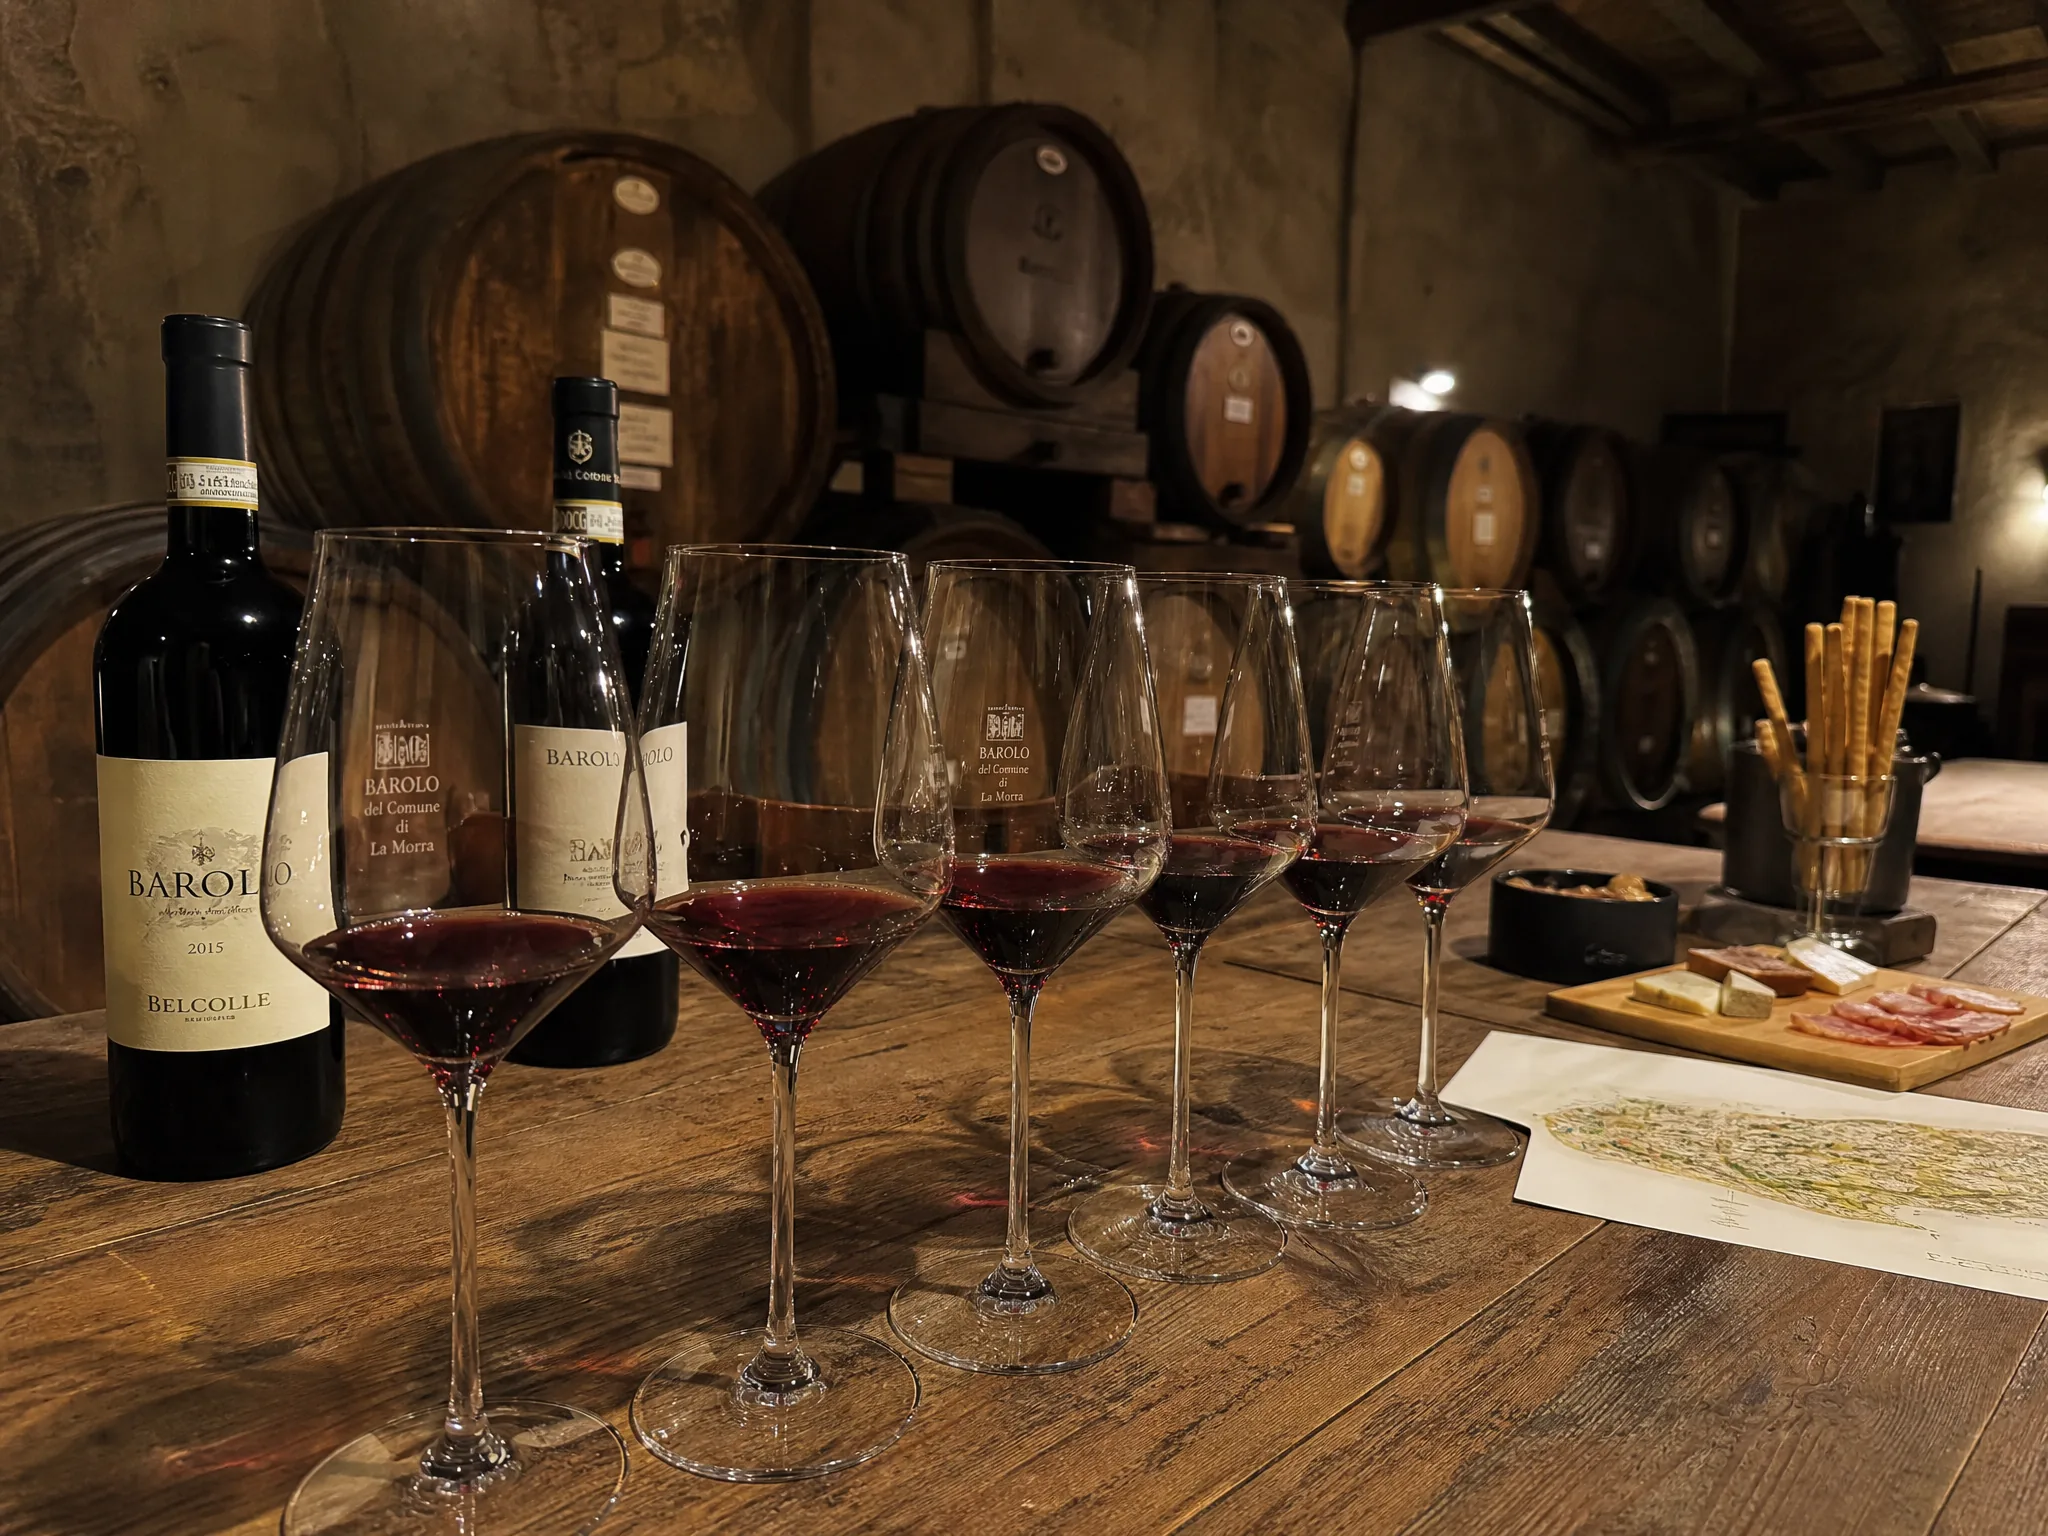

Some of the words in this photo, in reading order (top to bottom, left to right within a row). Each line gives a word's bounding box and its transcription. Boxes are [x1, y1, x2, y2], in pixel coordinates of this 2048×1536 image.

[979, 746, 1030, 760] BAROLO
[978, 763, 991, 775] del
[992, 764, 1029, 774] Comune
[364, 775, 440, 796] BAROLO
[998, 777, 1008, 788] di
[980, 792, 992, 802] La
[995, 791, 1024, 802] Morra
[364, 801, 383, 816] del
[386, 800, 441, 815] Comune
[395, 819, 409, 833] di
[370, 842, 387, 856] La
[392, 839, 435, 854] Morra
[187, 942, 225, 956] 2015
[147, 992, 272, 1014] BELCOLLE
